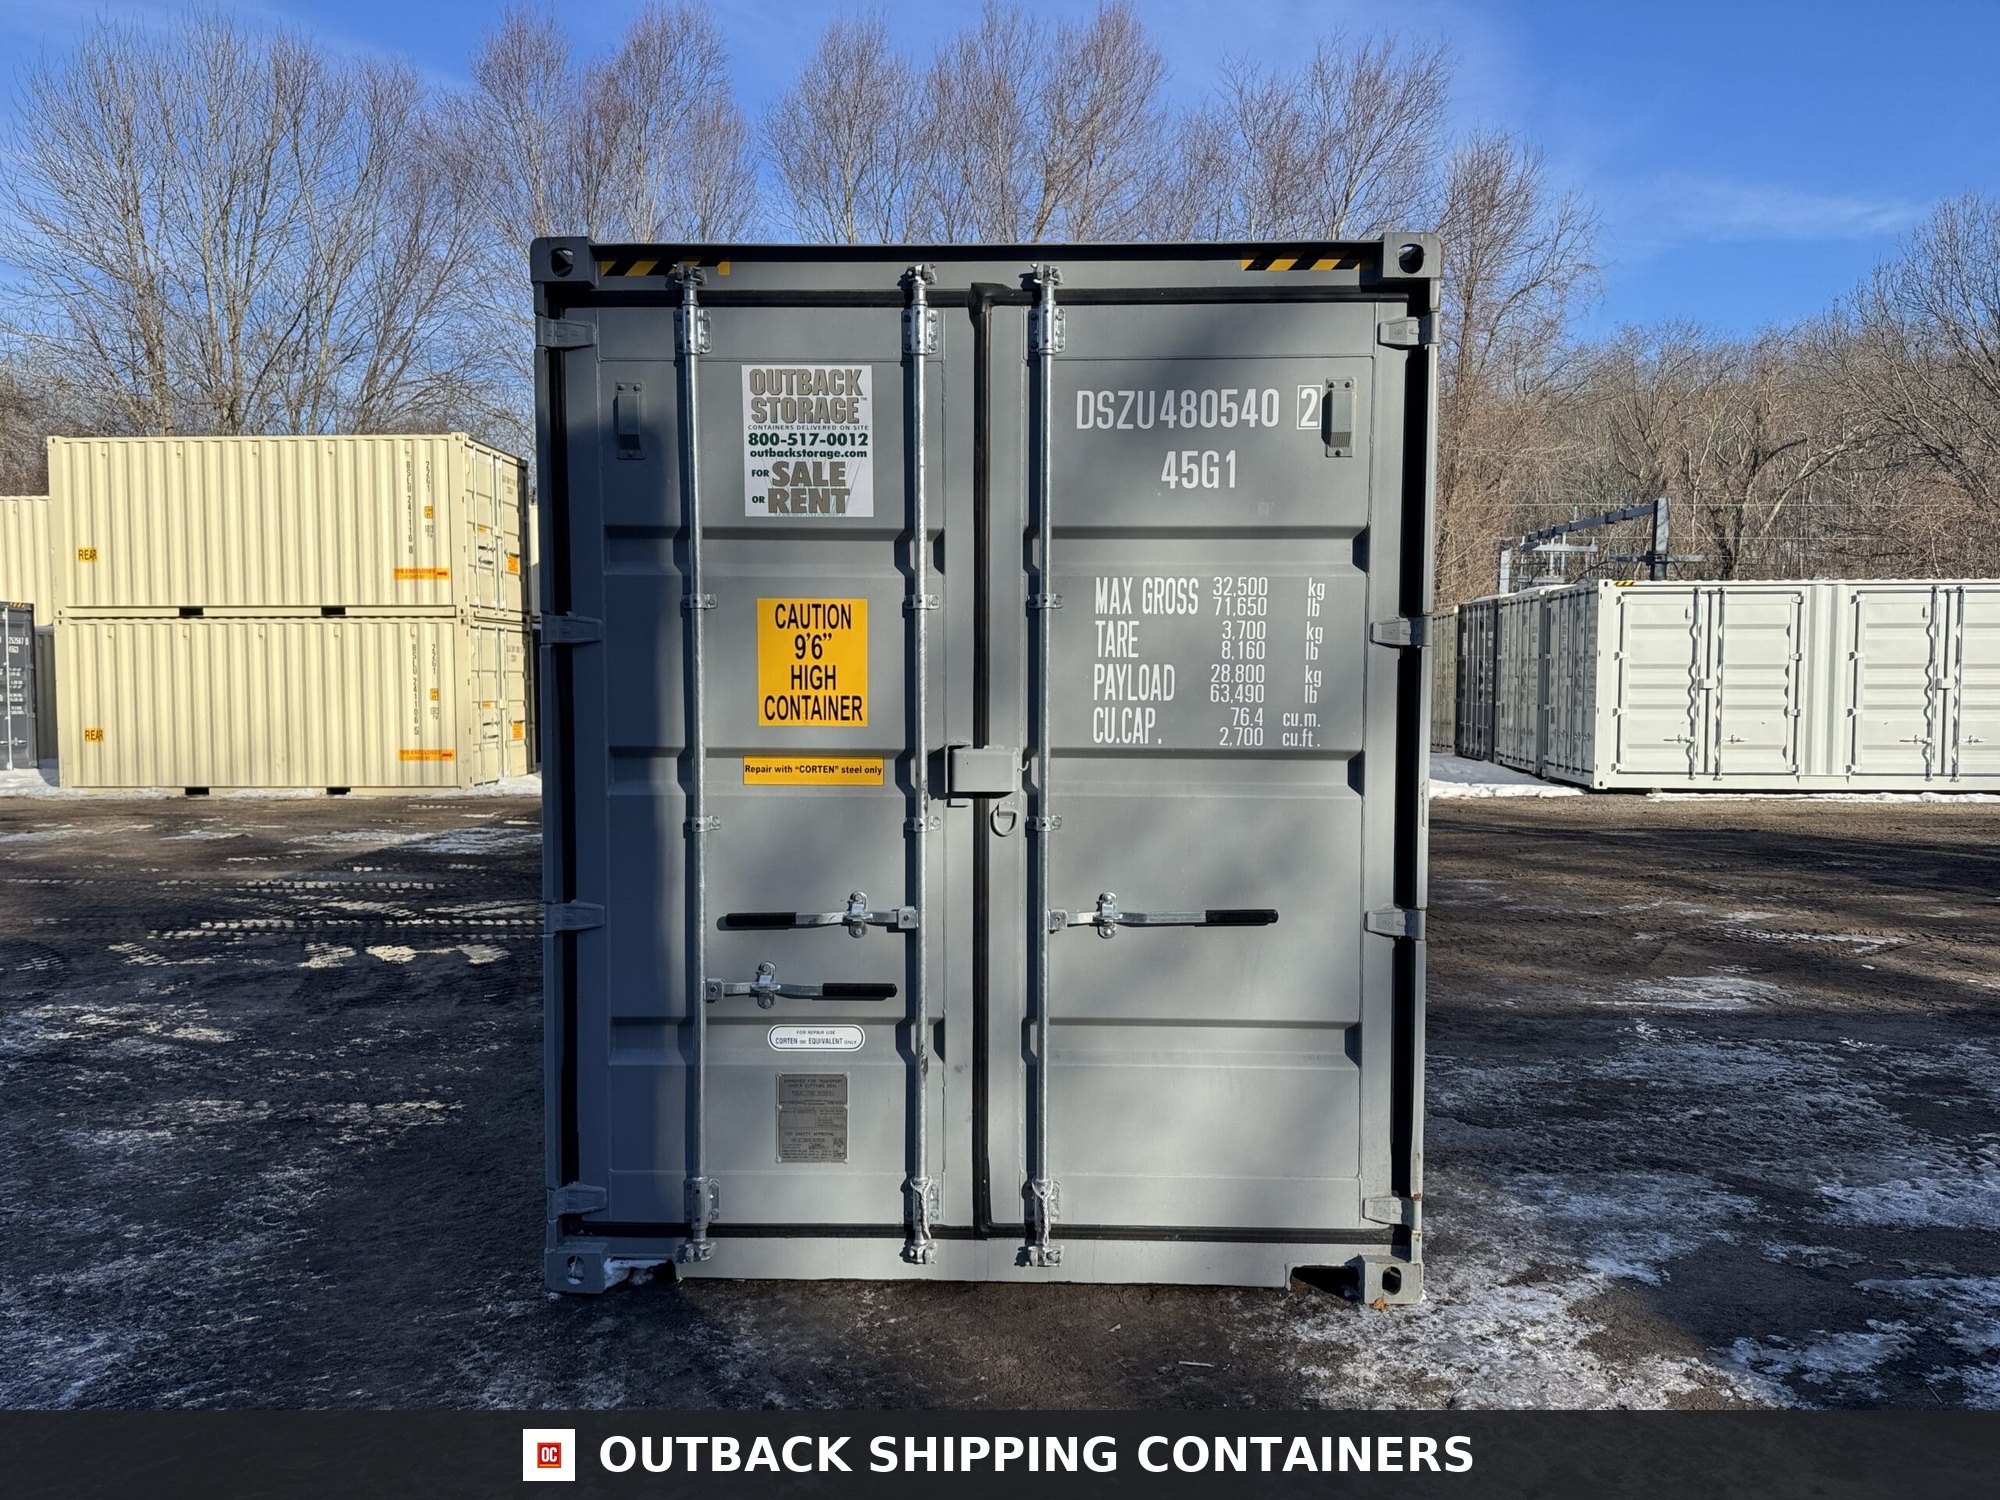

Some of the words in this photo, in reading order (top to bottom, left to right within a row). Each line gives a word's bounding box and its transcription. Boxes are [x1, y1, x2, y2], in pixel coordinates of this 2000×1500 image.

[749, 368, 863, 396] OUTBACK
[751, 396, 860, 424] STORAGE
[1299, 386, 1321, 428] 2
[748, 432, 868, 446] 800-517-0012
[750, 447, 867, 460] outbackstorage.com
[751, 469, 770, 478] FOR
[771, 460, 847, 487] SALE
[1161, 450, 1236, 489] 45G1
[751, 495, 765, 504] OR
[767, 488, 851, 514] RENT
[78, 549, 97, 560] REAR
[1095, 577, 1133, 615] MAX
[1142, 577, 1199, 615] GROSS
[1212, 577, 1268, 597] 32,500
[1308, 577, 1326, 600] kg
[1213, 597, 1267, 617] 71,650
[1306, 597, 1320, 617] lb
[774, 603, 852, 630] CAUTION
[1095, 620, 1140, 658] TARE
[1222, 620, 1266, 641] 3,700
[1306, 621, 1324, 644] kg
[1221, 641, 1266, 660] 8,160
[1305, 641, 1319, 660] lb
[790, 664, 837, 691] HIGH
[1093, 664, 1175, 701] PAYLOAD
[1210, 664, 1265, 684] 28,800
[1305, 665, 1322, 688] kg
[1210, 684, 1264, 704] 63,490
[1304, 684, 1318, 704] lb
[764, 695, 863, 721] CONTAINER
[1230, 707, 1264, 727] 76.4
[85, 730, 104, 741] REAR
[1219, 727, 1263, 746] 2,700
[744, 764, 772, 774] Repair
[774, 764, 793, 773] with
[841, 765, 862, 774] steel
[864, 766, 882, 776] only
[775, 1037, 798, 1045] CORTEN
[808, 1037, 843, 1045] EQUIVALENT
